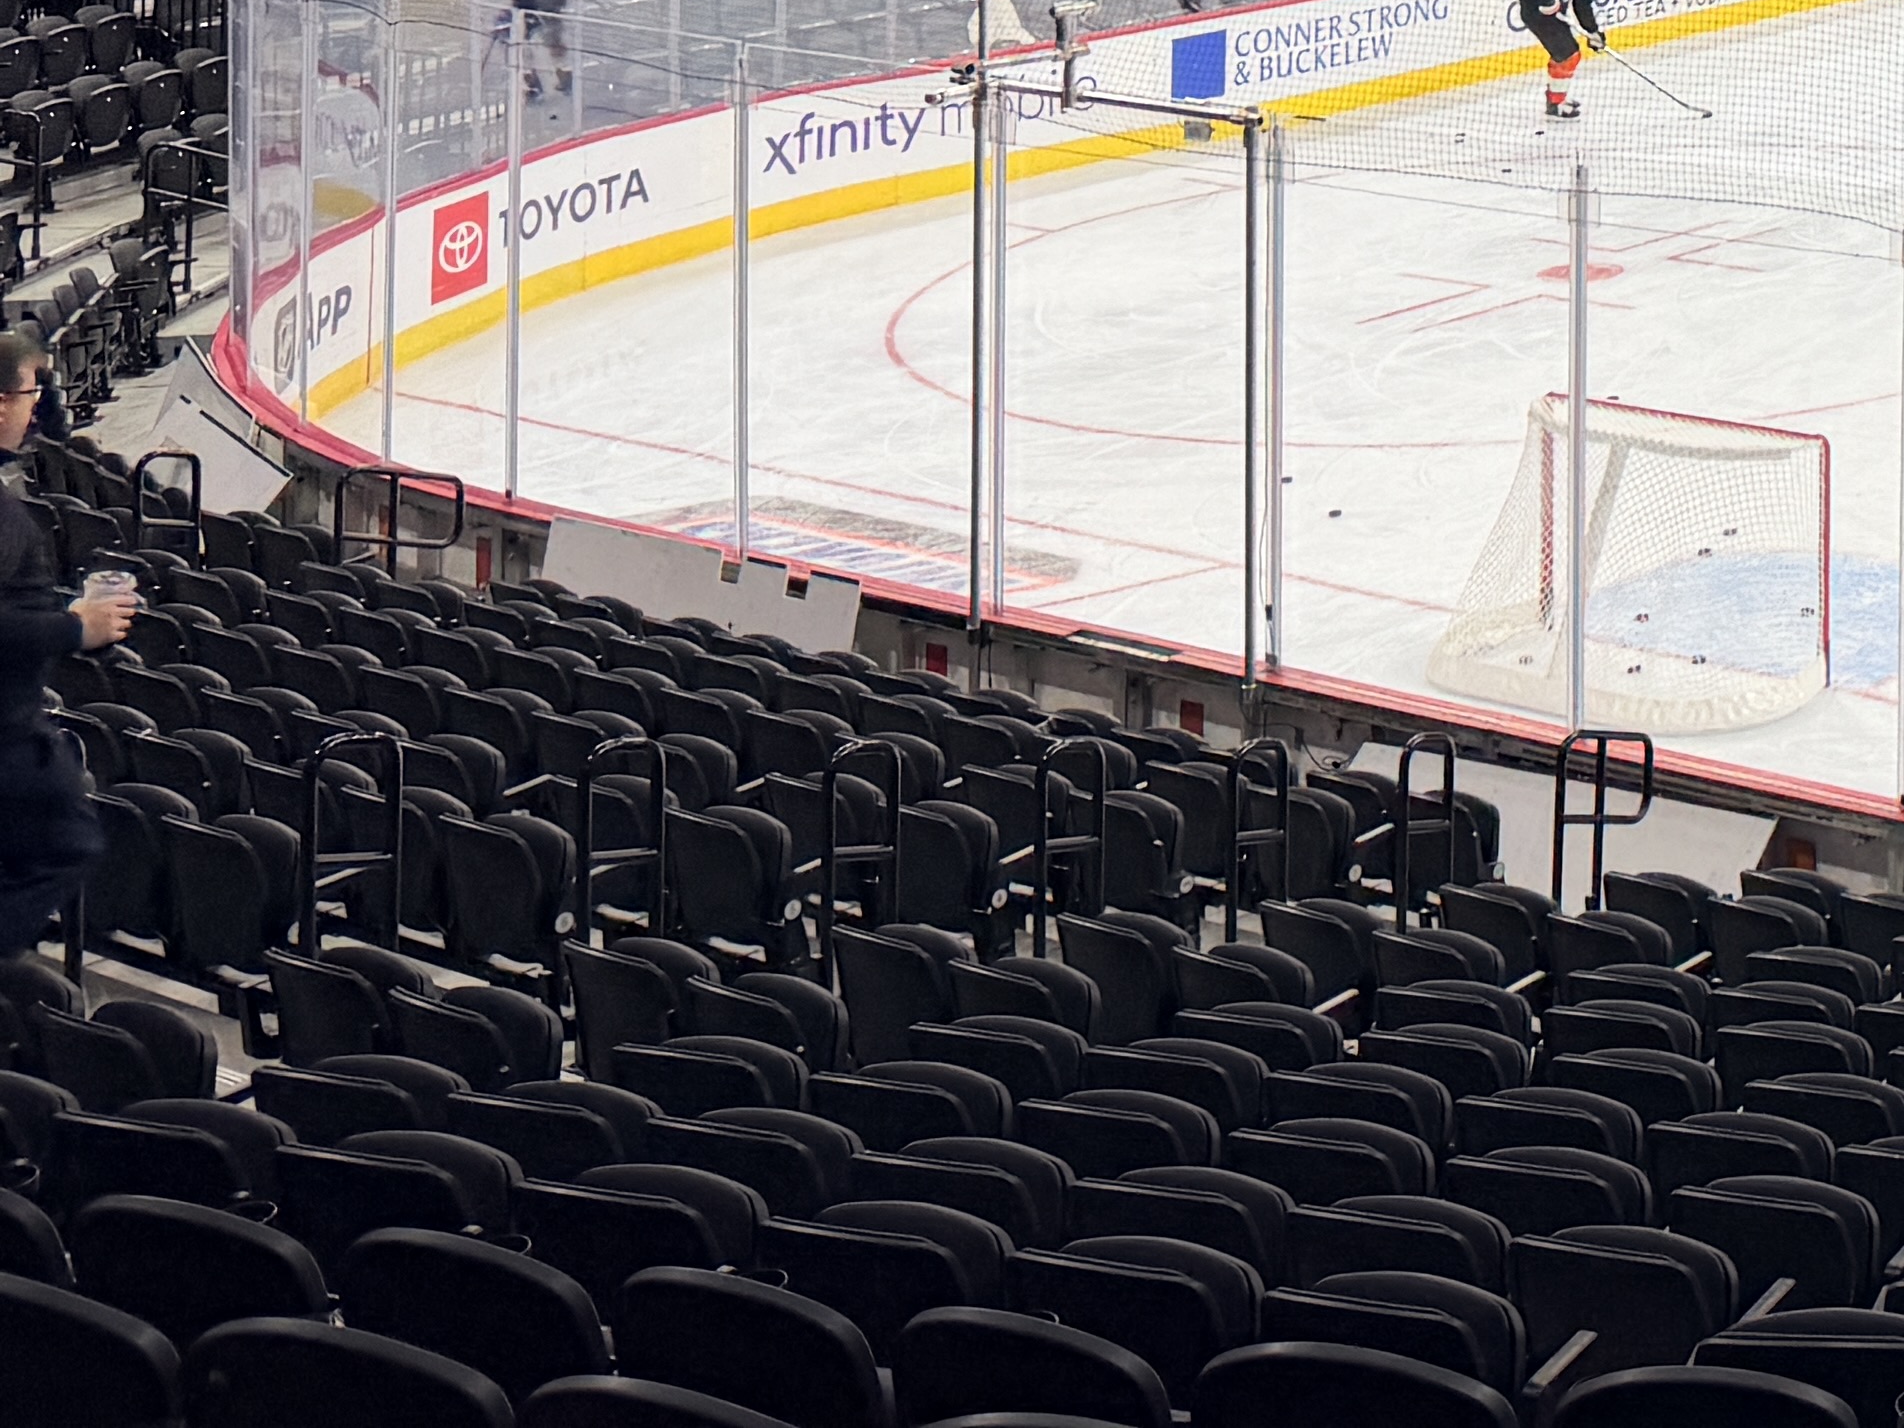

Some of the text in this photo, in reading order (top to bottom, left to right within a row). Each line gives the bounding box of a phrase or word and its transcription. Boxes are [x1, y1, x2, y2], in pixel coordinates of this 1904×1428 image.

[1234, 15, 1343, 57] CONNER
[1632, 0, 1666, 19] TEA
[1234, 31, 1394, 86] & BUCKELEW
[762, 101, 926, 175] xfinity
[498, 167, 651, 248] TOYOTA
